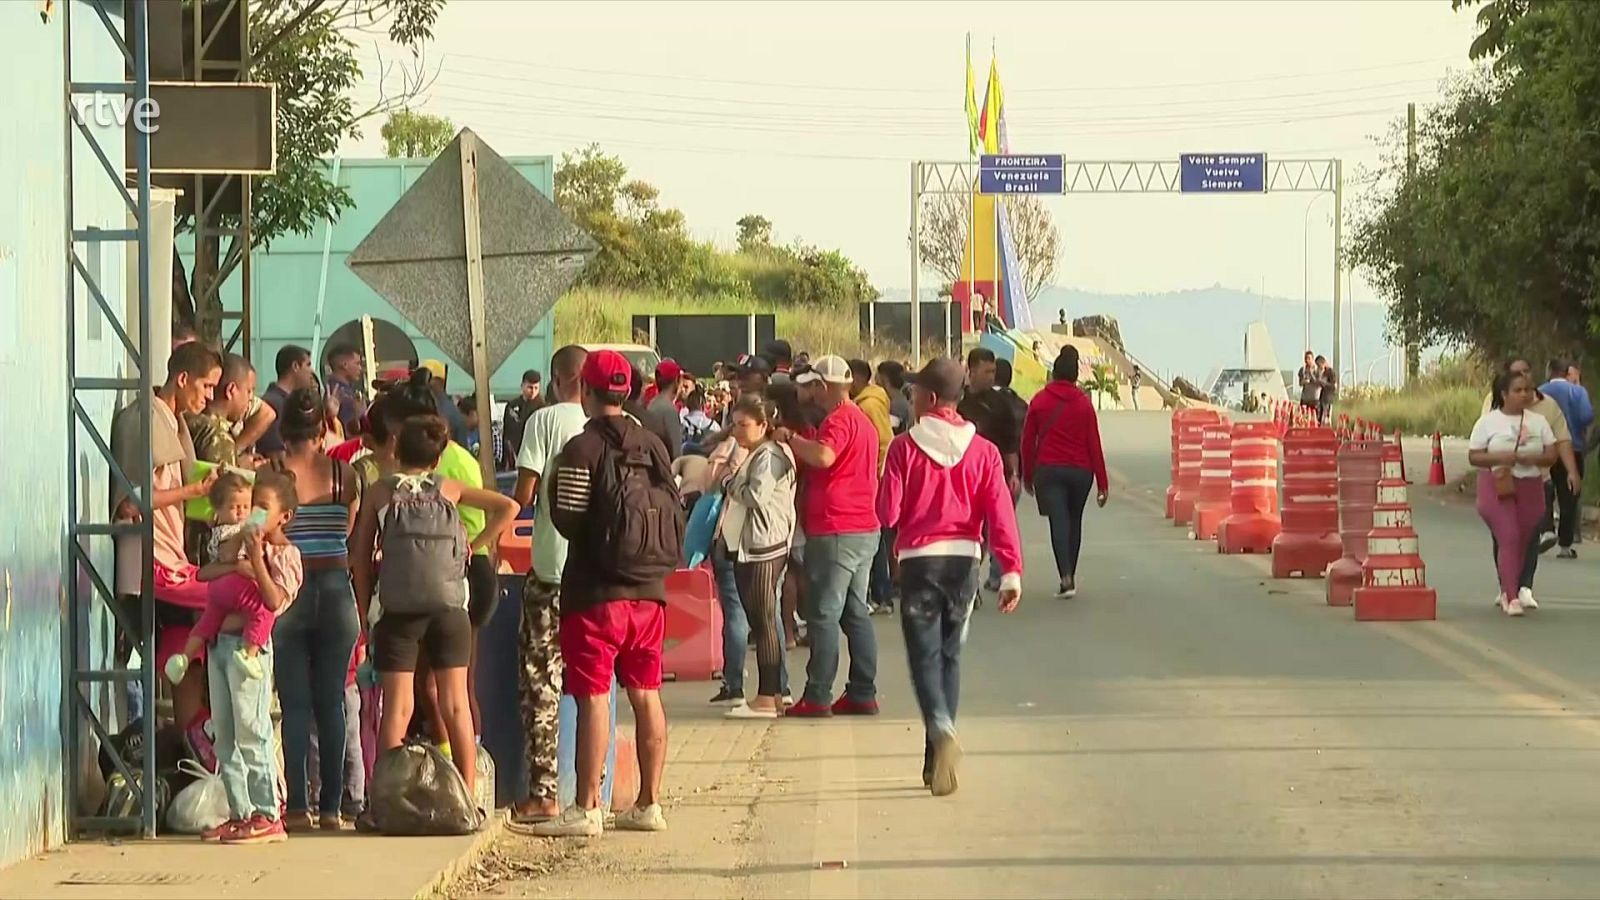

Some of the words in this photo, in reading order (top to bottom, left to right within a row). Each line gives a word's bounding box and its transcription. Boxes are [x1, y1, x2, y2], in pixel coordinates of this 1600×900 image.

[995, 157, 1047, 166] FRONTEIRA
[1218, 156, 1256, 166] Sempre
[994, 171, 1050, 180] Venezuela
[1205, 168, 1240, 176] Vuelva
[1005, 183, 1038, 192] Brasil
[1201, 180, 1244, 189] Siempre
